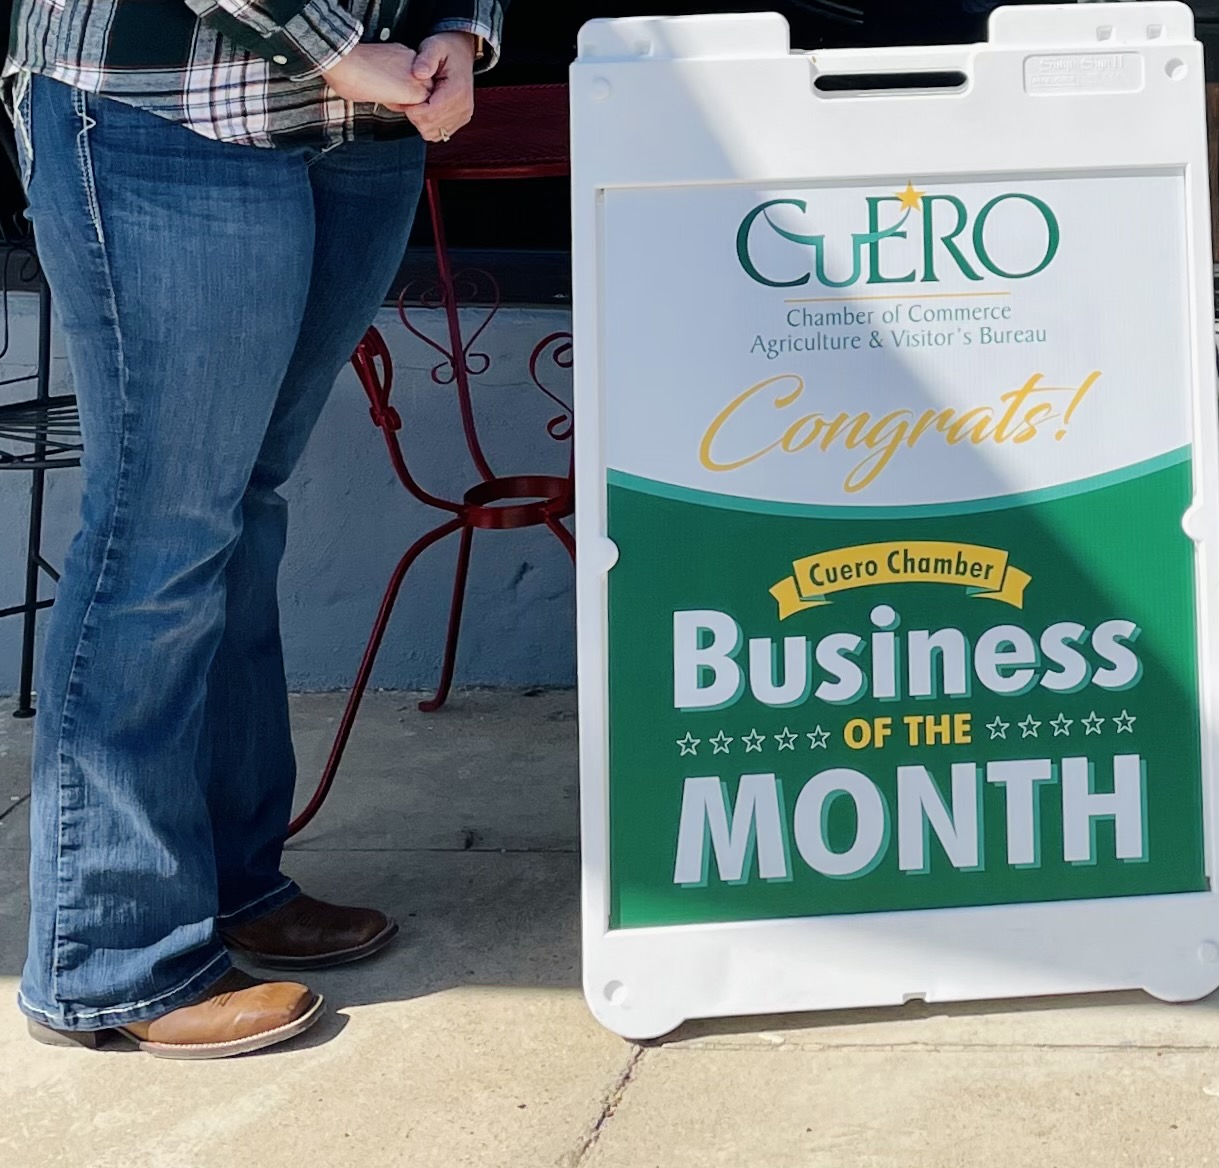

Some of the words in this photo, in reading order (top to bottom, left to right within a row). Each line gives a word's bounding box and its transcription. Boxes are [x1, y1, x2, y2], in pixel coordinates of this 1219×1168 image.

[736, 193, 1060, 289] CUERO
[749, 331, 862, 360] Agriculture
[868, 330, 884, 349] &
[890, 327, 972, 348] Visitor's
[979, 326, 1047, 346] Bureau
[786, 306, 875, 328] Chamber
[882, 303, 904, 324] of
[907, 303, 1012, 324] Commerce
[699, 371, 1102, 494] Congrats!
[808, 556, 879, 588] Cuero
[886, 549, 995, 581] Chamber
[673, 604, 1142, 712] Business
[843, 716, 893, 750] OF
[903, 712, 972, 746] THE
[673, 753, 1149, 888] MONTH
